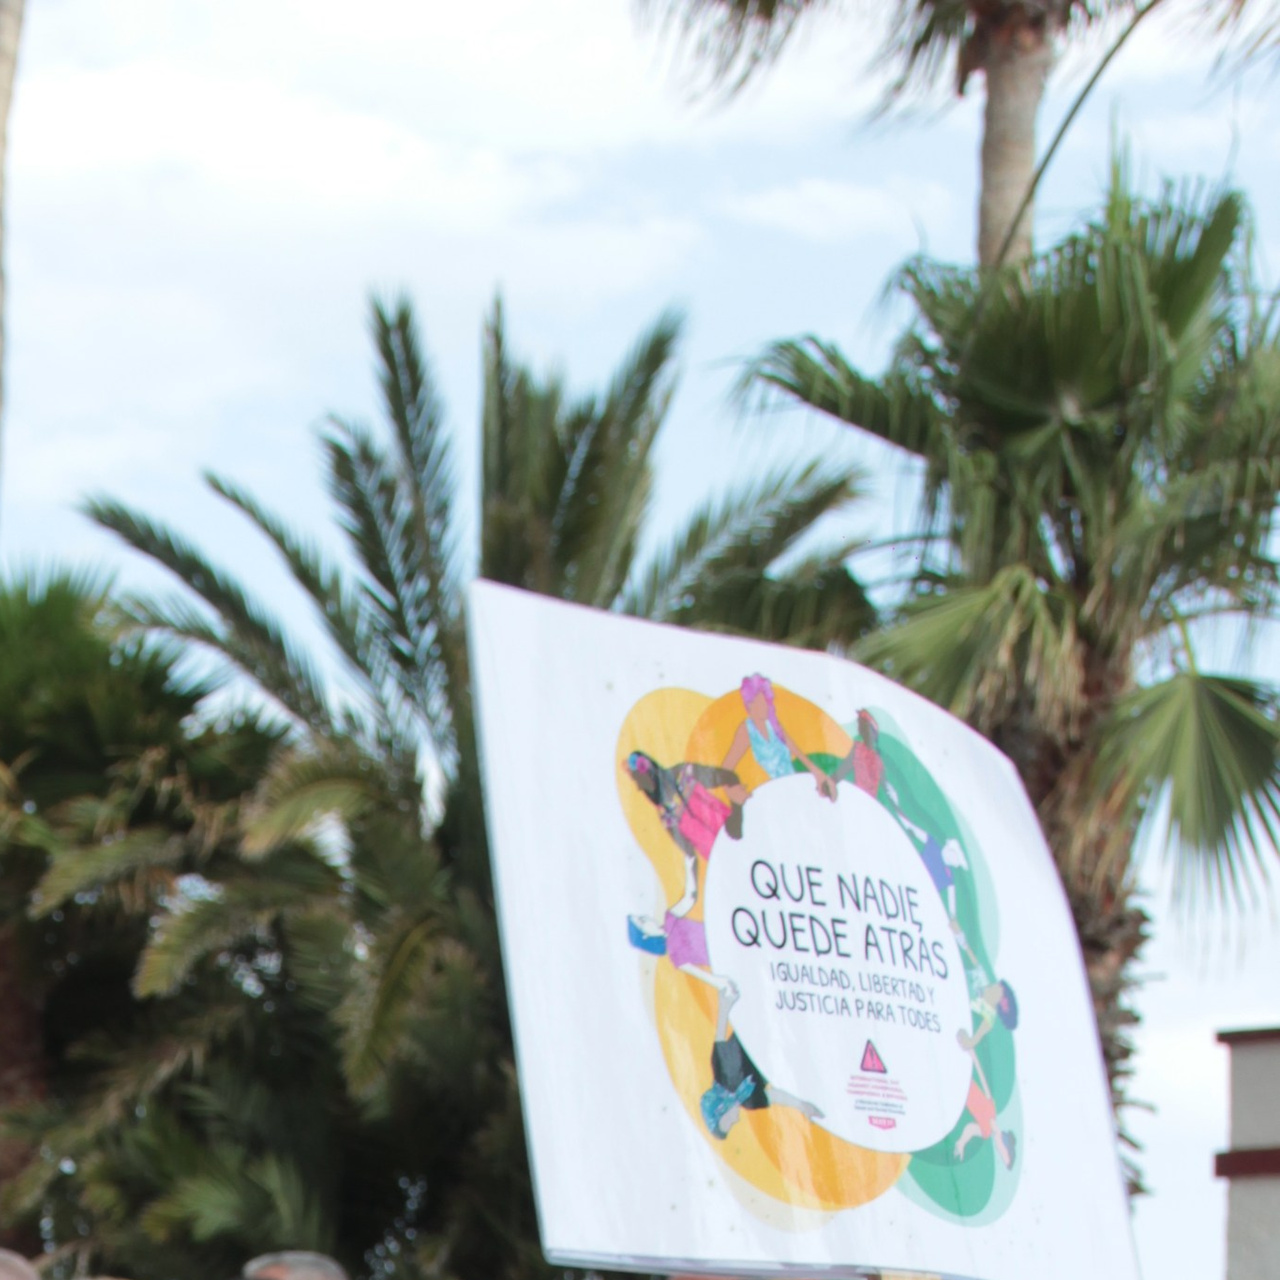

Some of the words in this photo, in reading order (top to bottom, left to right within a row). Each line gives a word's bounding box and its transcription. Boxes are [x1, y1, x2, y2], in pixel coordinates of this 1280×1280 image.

[751, 859, 827, 906] QUE
[731, 906, 852, 958] QUEDE
[770, 961, 856, 992] IGUALDAD,
[858, 971, 926, 1004] LIBERTAD
[926, 985, 935, 1006] Y
[775, 989, 852, 1018] JUSTICIA
[855, 998, 896, 1023] PARA
[897, 1004, 942, 1034] TODES
